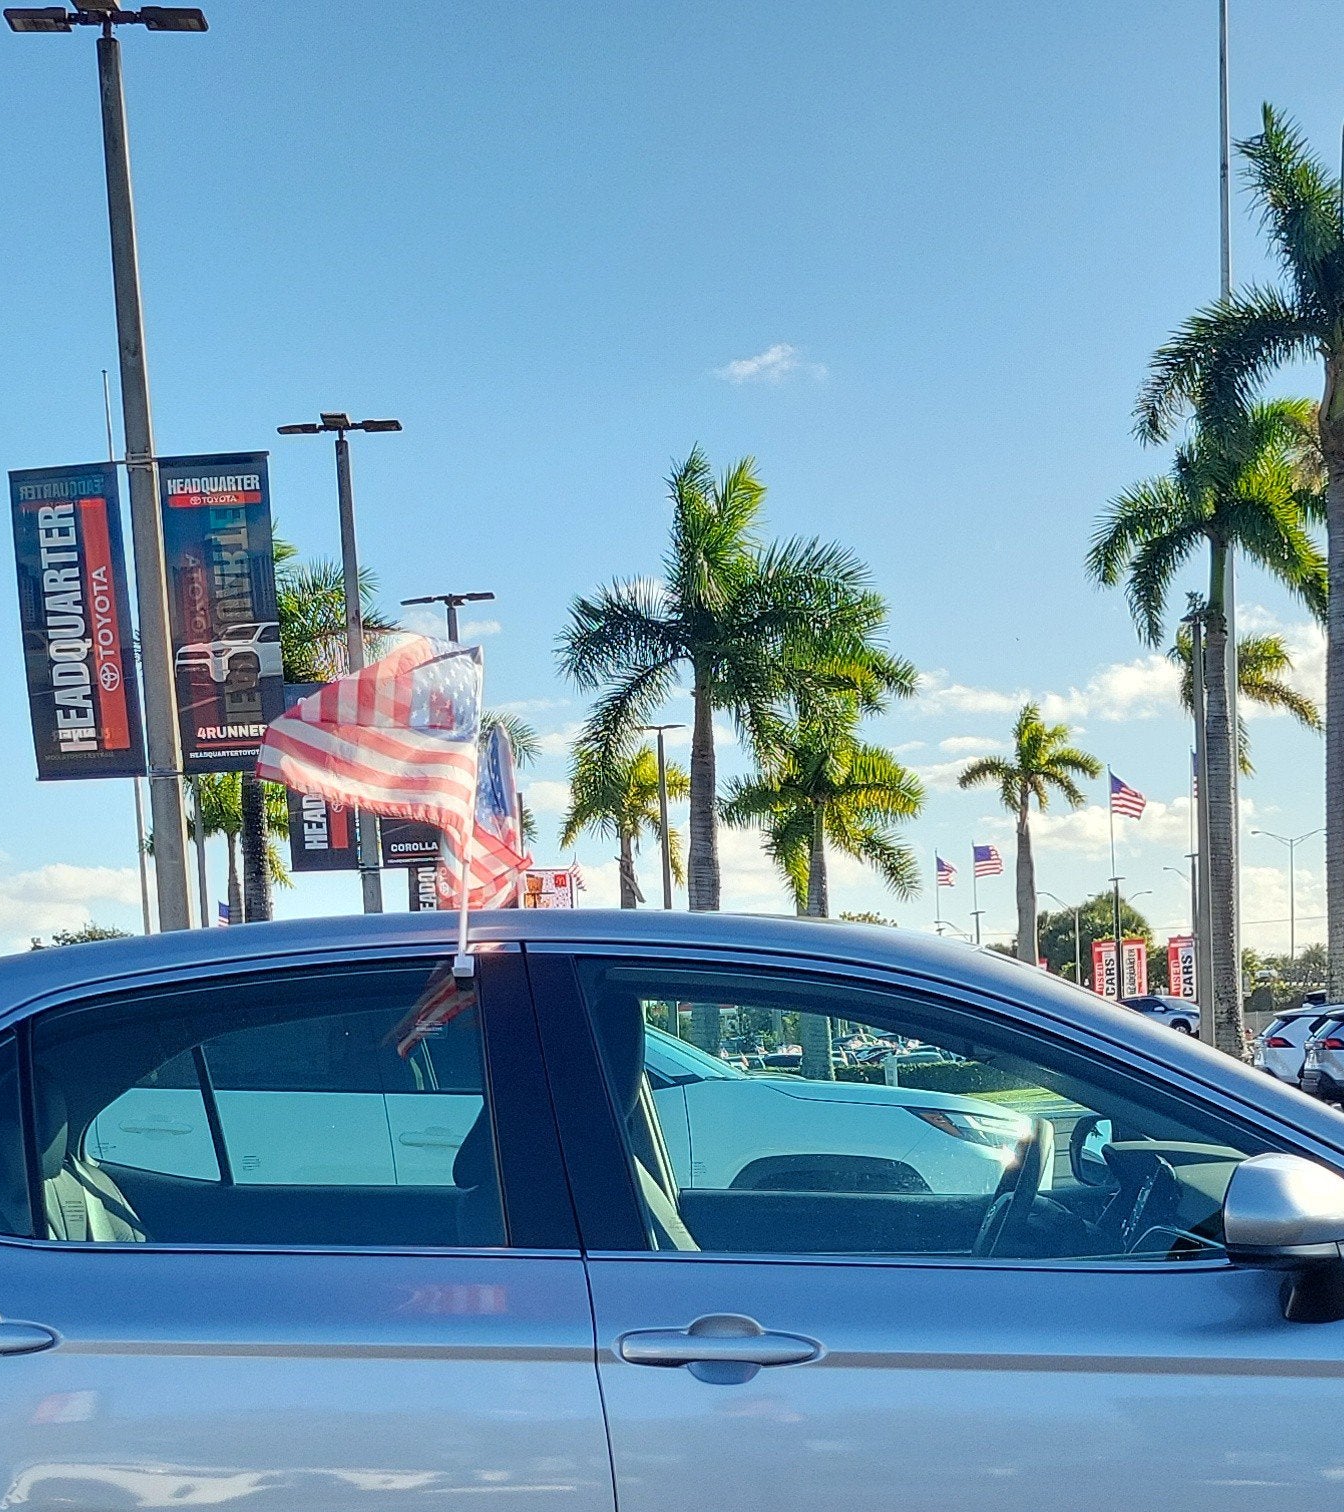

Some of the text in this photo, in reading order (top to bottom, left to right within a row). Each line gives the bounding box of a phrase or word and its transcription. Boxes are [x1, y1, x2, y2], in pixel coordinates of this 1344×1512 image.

[167, 474, 260, 495] HEADQUARTER
[201, 495, 237, 504] TOYOTA
[38, 503, 98, 753] HEADQUARTER
[92, 566, 115, 661] TOYOTA
[391, 842, 439, 852] COROLLA
[1096, 963, 1104, 991] USED
[1105, 958, 1115, 996] CARS
[1173, 961, 1181, 991] USED
[1181, 954, 1194, 997] CARS
